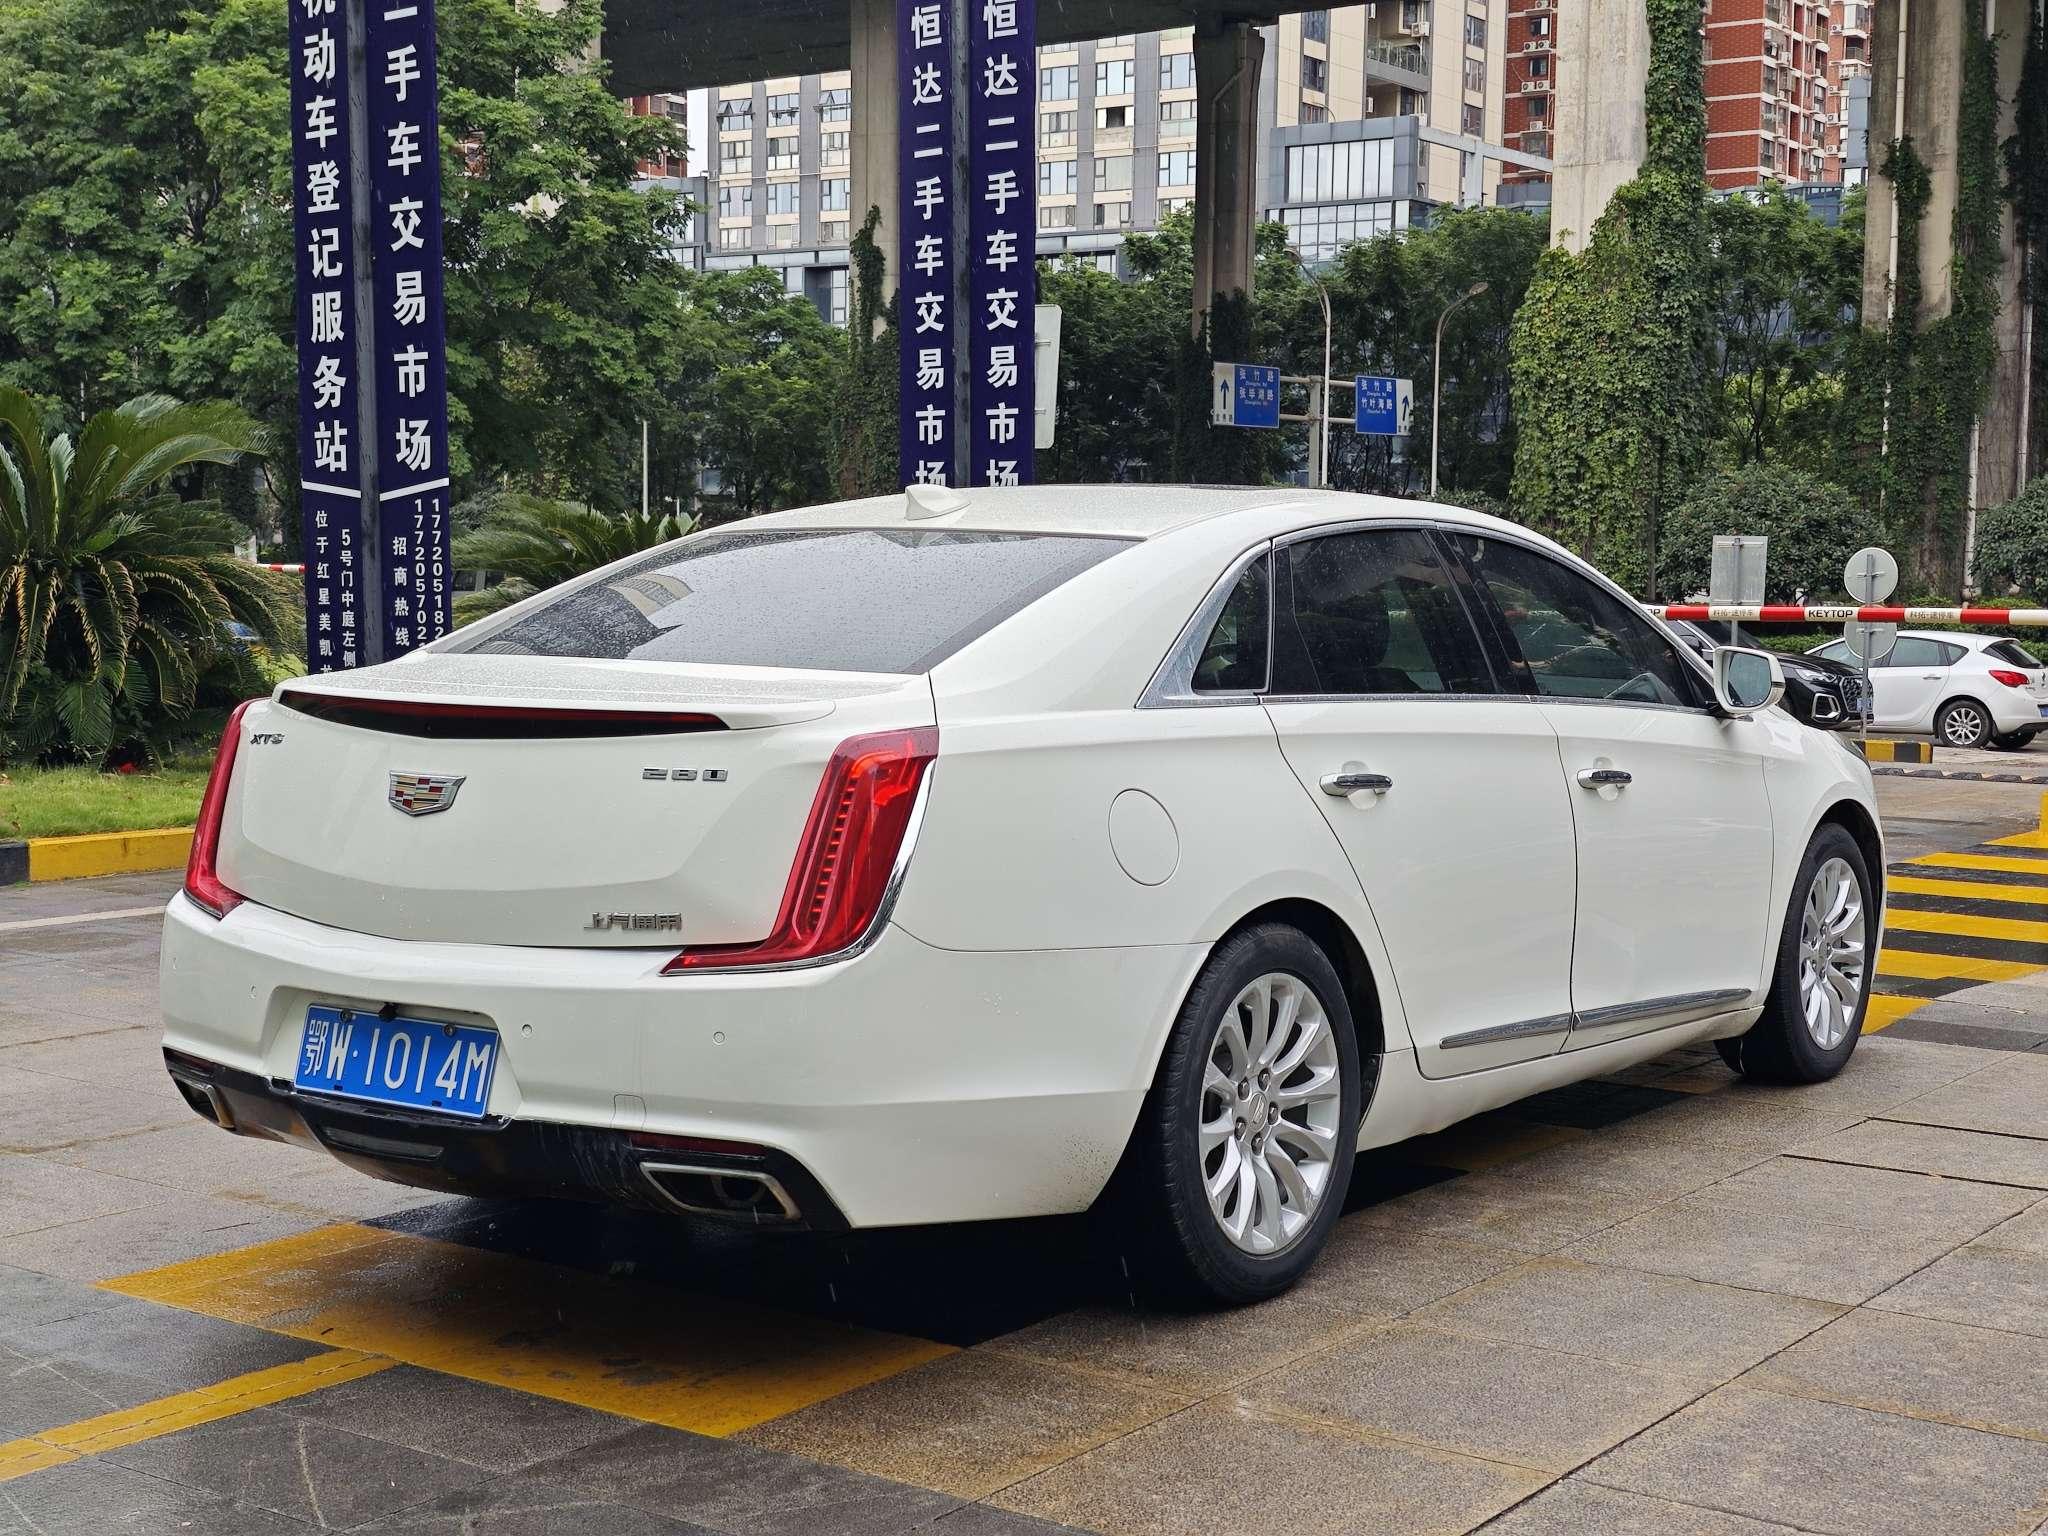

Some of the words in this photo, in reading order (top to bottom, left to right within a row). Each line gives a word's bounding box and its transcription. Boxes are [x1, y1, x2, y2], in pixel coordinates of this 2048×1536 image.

[911, 4, 947, 486] 恒达二手车交易市场
[983, 0, 1020, 487] 恒达二手车交易市场
[340, 528, 356, 668] 5号门中庭左侧
[392, 536, 410, 647] 招商热线
[414, 498, 427, 648] 177205702
[1808, 609, 1853, 618] KEYTOP
[250, 733, 285, 745] XTS
[584, 911, 682, 930] 上汽通用
